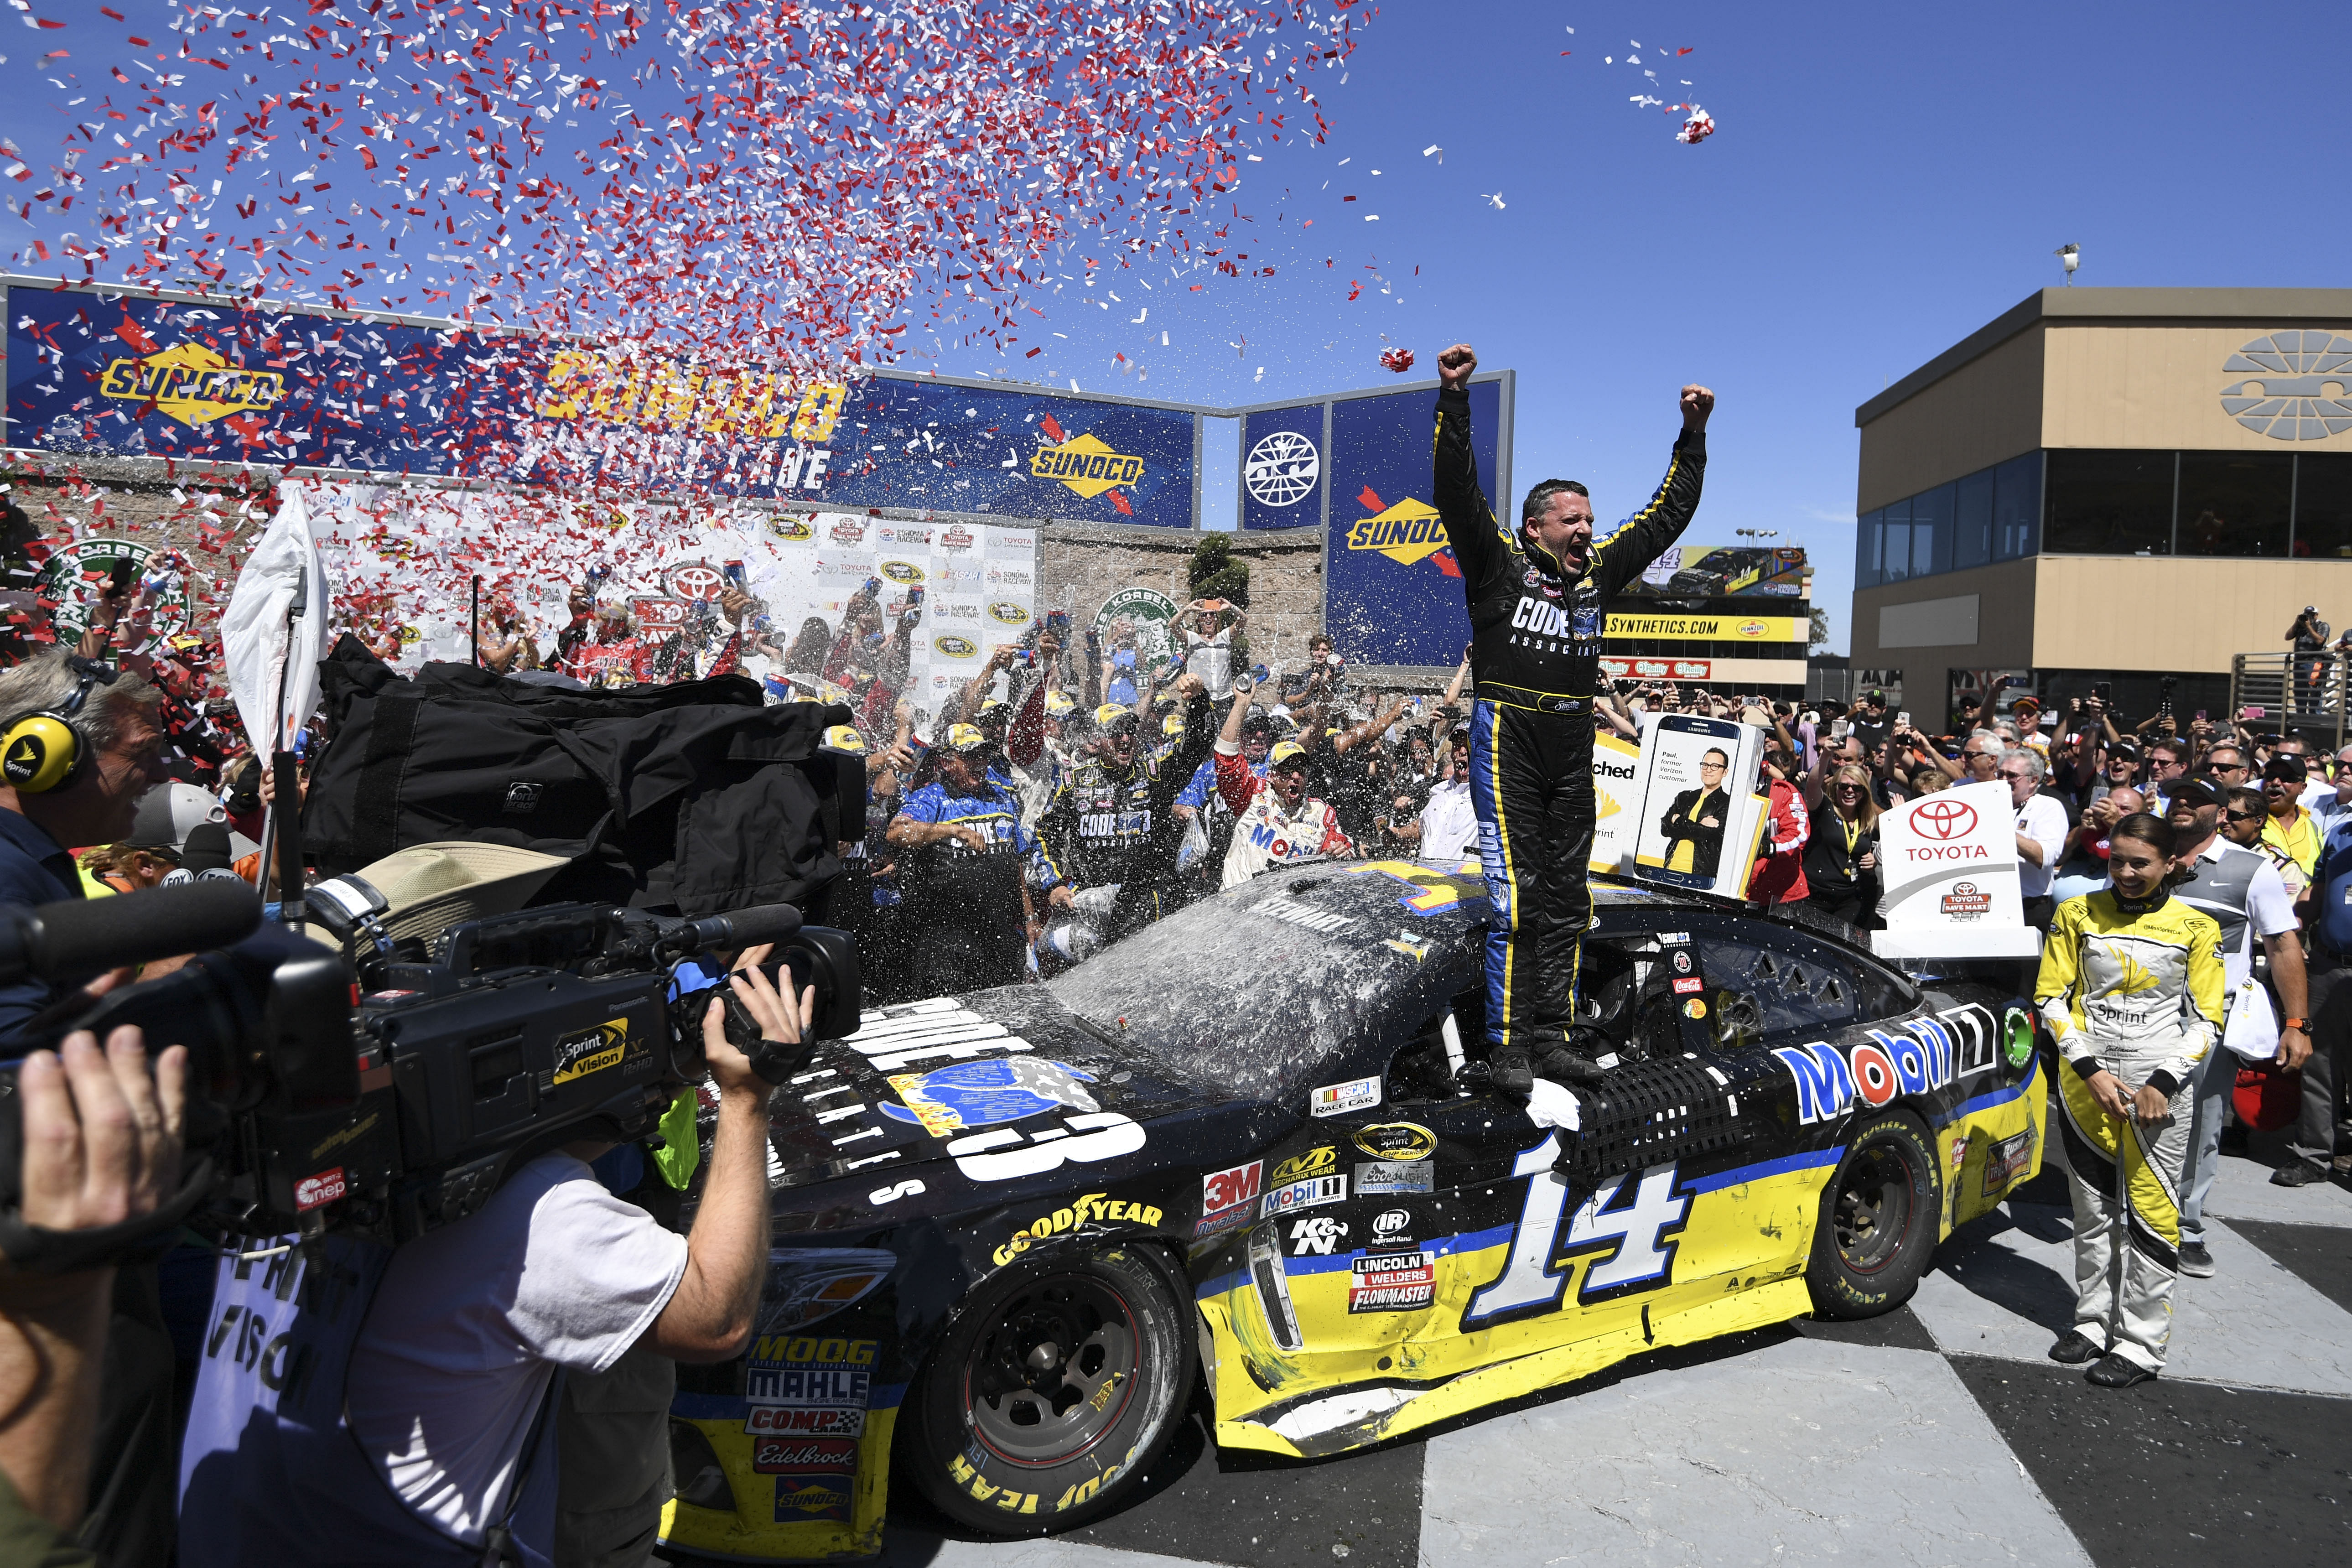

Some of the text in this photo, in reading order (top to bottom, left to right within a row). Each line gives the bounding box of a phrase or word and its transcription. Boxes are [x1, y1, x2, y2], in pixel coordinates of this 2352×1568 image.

[105, 363, 283, 406] SUNOCO
[1036, 451, 1142, 483] SUNOCO
[1352, 518, 1450, 547] SUNOC
[1738, 565, 1751, 584] 14
[1112, 591, 1169, 610] KORBEL
[1511, 596, 1569, 638] CODE
[1637, 661, 1667, 673] O'Reilly
[1676, 662, 1706, 674] O'Reilly
[1554, 699, 1580, 711] Smoke
[5, 759, 32, 778] Sprint
[1593, 761, 1635, 780] ched
[1660, 766, 1682, 774] Verizon
[1661, 758, 1682, 767] former
[1658, 774, 1688, 783] customer
[507, 800, 535, 810] brace
[509, 792, 539, 801] porta
[1080, 810, 1152, 837] CODE 3
[1478, 821, 1503, 878] CODE
[1905, 845, 1989, 861] TOYOTA
[167, 874, 187, 887] FOX
[1950, 912, 1981, 922] 350
[2123, 903, 2144, 912] Sprint
[1662, 932, 1690, 944] CODE 3
[2144, 924, 2182, 935] @MissSprintCup
[609, 995, 649, 1012] Panasonic
[2005, 1007, 2029, 1030] AMERICAN
[2098, 1004, 2147, 1025] Sprint
[565, 1034, 601, 1059] Sprint
[2008, 1045, 2032, 1066] ETHANOL
[2105, 1045, 2139, 1054] Julianna
[578, 1052, 619, 1073] Vision
[1771, 1011, 1985, 1126] Mobil 1
[1336, 1082, 1368, 1100] NASCAR
[1316, 1097, 1373, 1113] RACE CAR
[1381, 1136, 1408, 1147] Sprint
[2003, 1137, 2024, 1157] RUSH
[2009, 1150, 2029, 1171] CENTERS
[322, 1172, 342, 1184] SRT-2
[1270, 1164, 1335, 1190] MECHANIX WEAR
[1366, 1170, 1394, 1182] Coors
[314, 1181, 345, 1201] nep
[1205, 1162, 1261, 1210] 3M
[1265, 1180, 1316, 1212] Mobil
[1312, 1194, 1340, 1204] LUBRICANTS
[1197, 1202, 1253, 1237] Duralast
[1378, 1213, 1404, 1231] IR
[1465, 1127, 1689, 1320] 14
[992, 1192, 1163, 1267] GOODYEAR
[1207, 1225, 1236, 1241] BRAKES
[1372, 1236, 1396, 1245] Ingersoll
[1357, 1255, 1421, 1273] LINCOLN
[1371, 1270, 1427, 1284] WELDERS
[1352, 1284, 1432, 1311] FLOWMASTER
[749, 1335, 877, 1365] MOOG
[754, 1360, 796, 1368] STEERING
[813, 1362, 867, 1371] SUSPENSION
[748, 1370, 868, 1398] MAHLE
[752, 1409, 838, 1430] COMP
[757, 1444, 854, 1466] Edelbrock
[780, 1493, 848, 1506] SUNOCO
